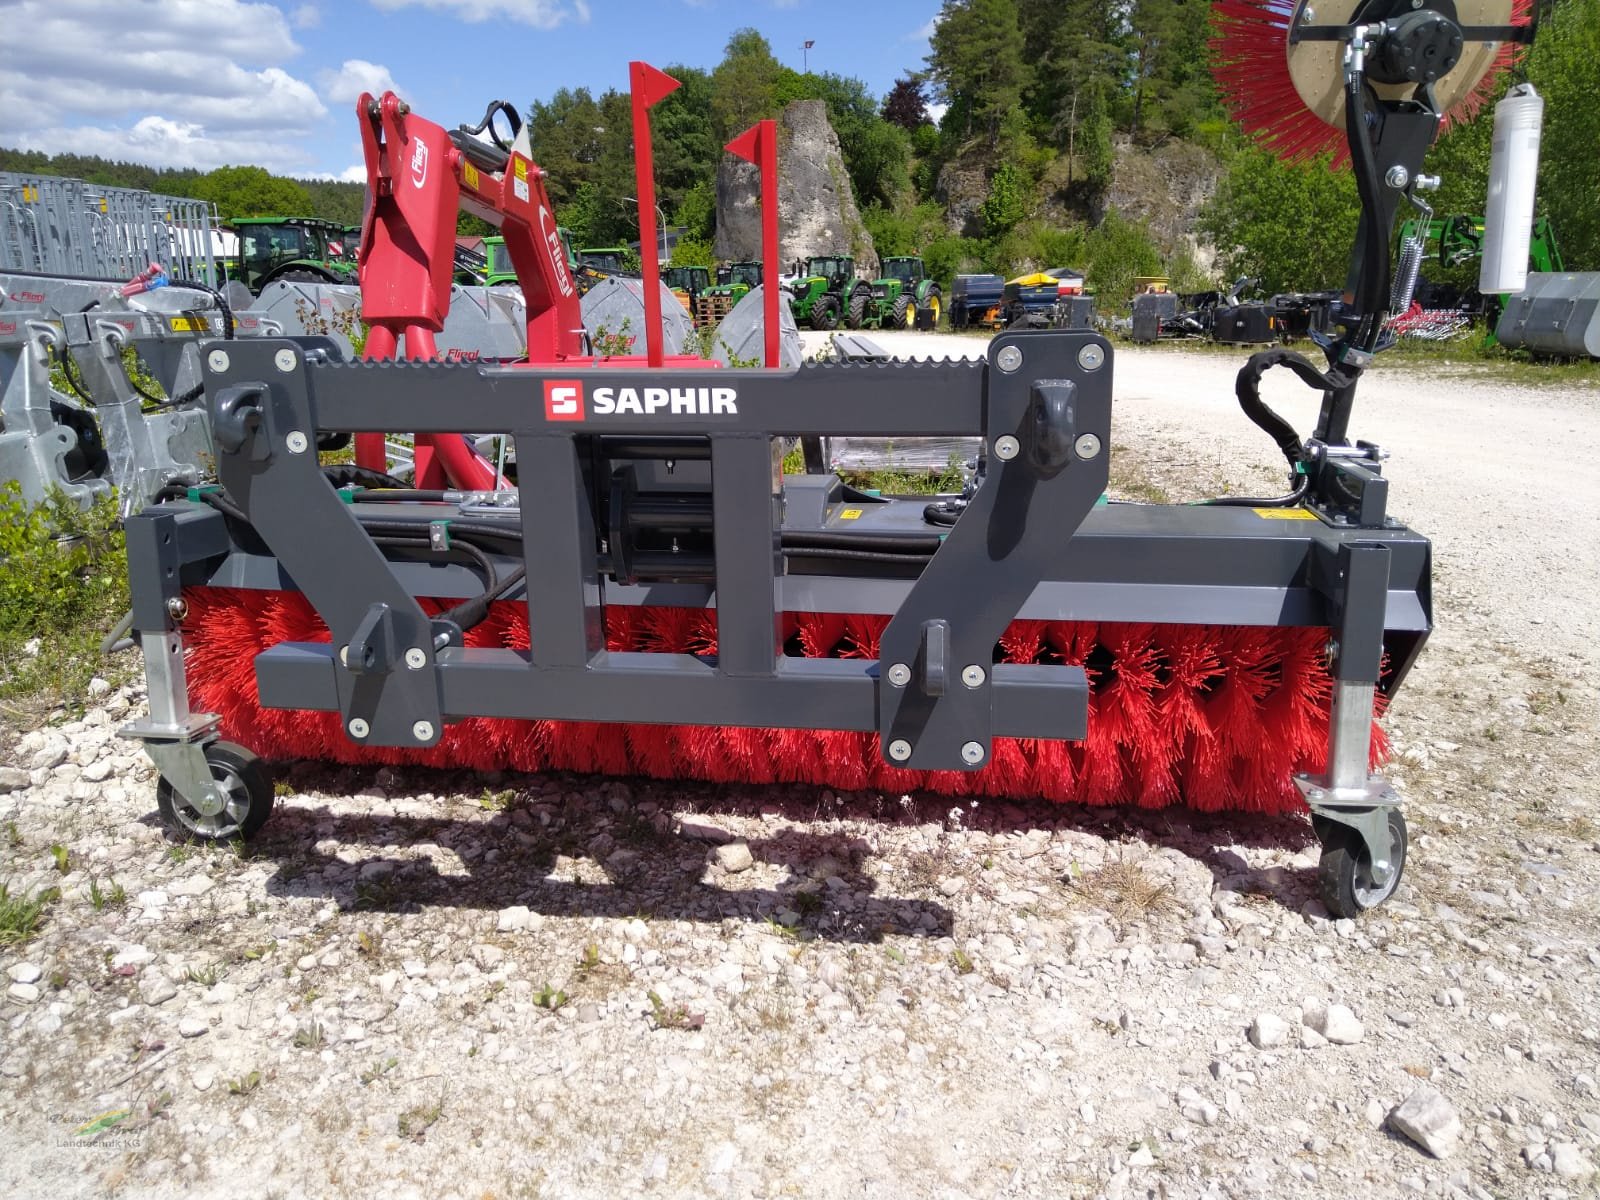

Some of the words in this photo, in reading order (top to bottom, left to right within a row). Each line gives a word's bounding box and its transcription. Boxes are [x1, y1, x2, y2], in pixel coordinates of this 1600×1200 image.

[412, 136, 426, 174] Fliegl
[548, 231, 573, 298] Fliegl
[448, 349, 479, 359] Fliegl
[592, 387, 738, 414] SAPHIR
